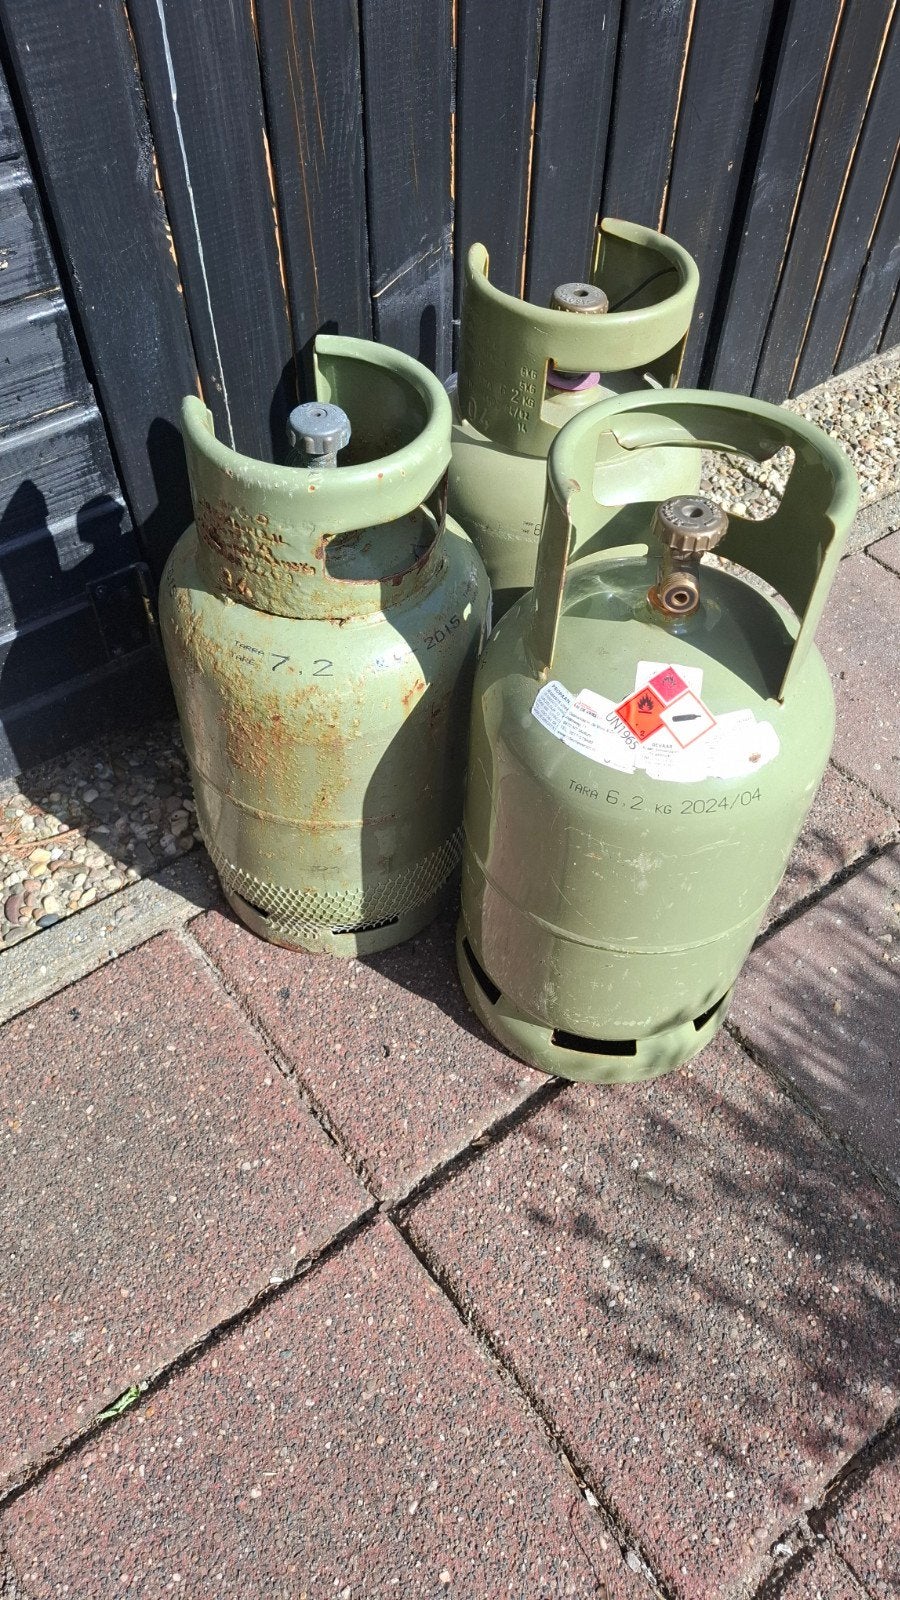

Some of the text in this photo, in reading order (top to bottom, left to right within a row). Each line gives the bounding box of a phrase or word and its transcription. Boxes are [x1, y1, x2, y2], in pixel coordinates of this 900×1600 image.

[424, 614, 460, 650] 2015
[605, 710, 640, 750] UN1965
[568, 779, 599, 800] TARA
[655, 804, 672, 815] KG
[680, 787, 762, 815] 2024/04
